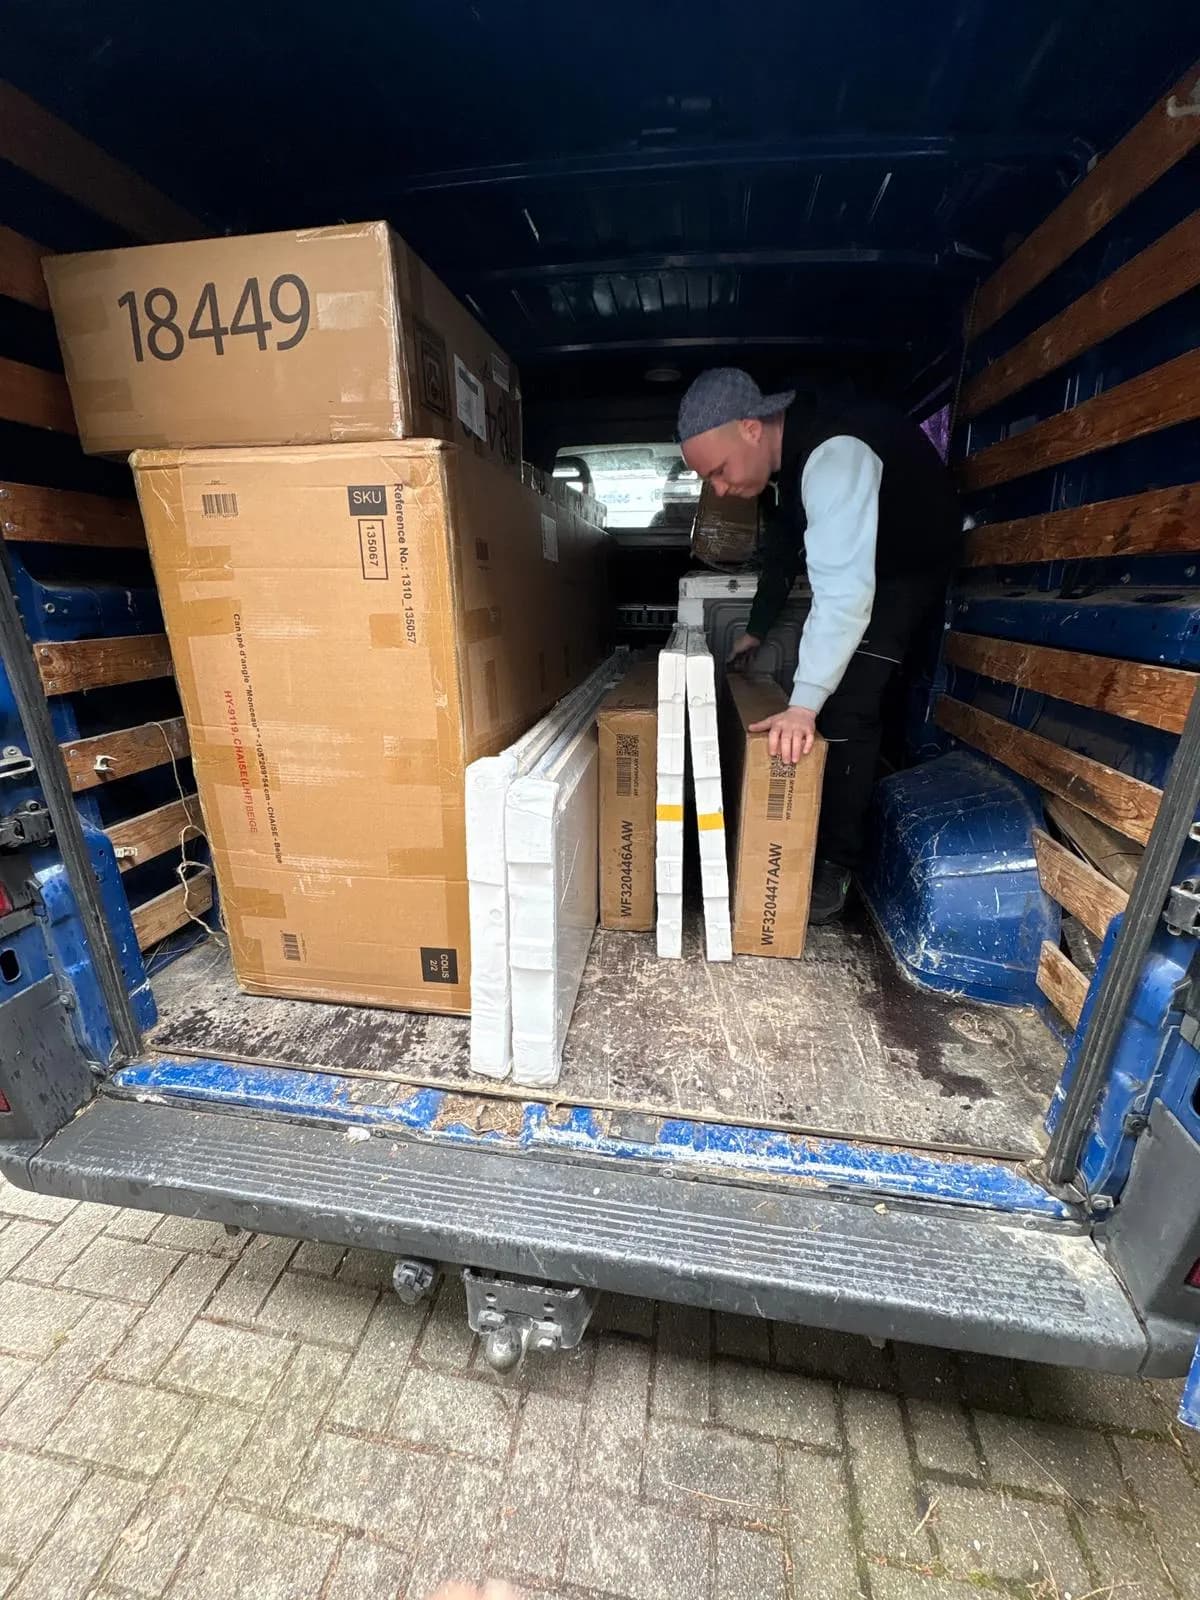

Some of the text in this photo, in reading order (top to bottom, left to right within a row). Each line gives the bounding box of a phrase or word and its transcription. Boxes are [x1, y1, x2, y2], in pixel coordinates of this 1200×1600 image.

[118, 273, 311, 363] 18449
[353, 490, 382, 504] SKU
[366, 525, 379, 567] 135067
[393, 483, 417, 644] Reference No.: 1310_135057
[267, 807, 279, 837] CHAISE
[273, 843, 282, 864] Beige
[618, 820, 634, 918] WF320446AAW
[760, 842, 784, 946] WF320447AAW
[429, 959, 438, 972] 2/2
[440, 953, 450, 979] COLIS
